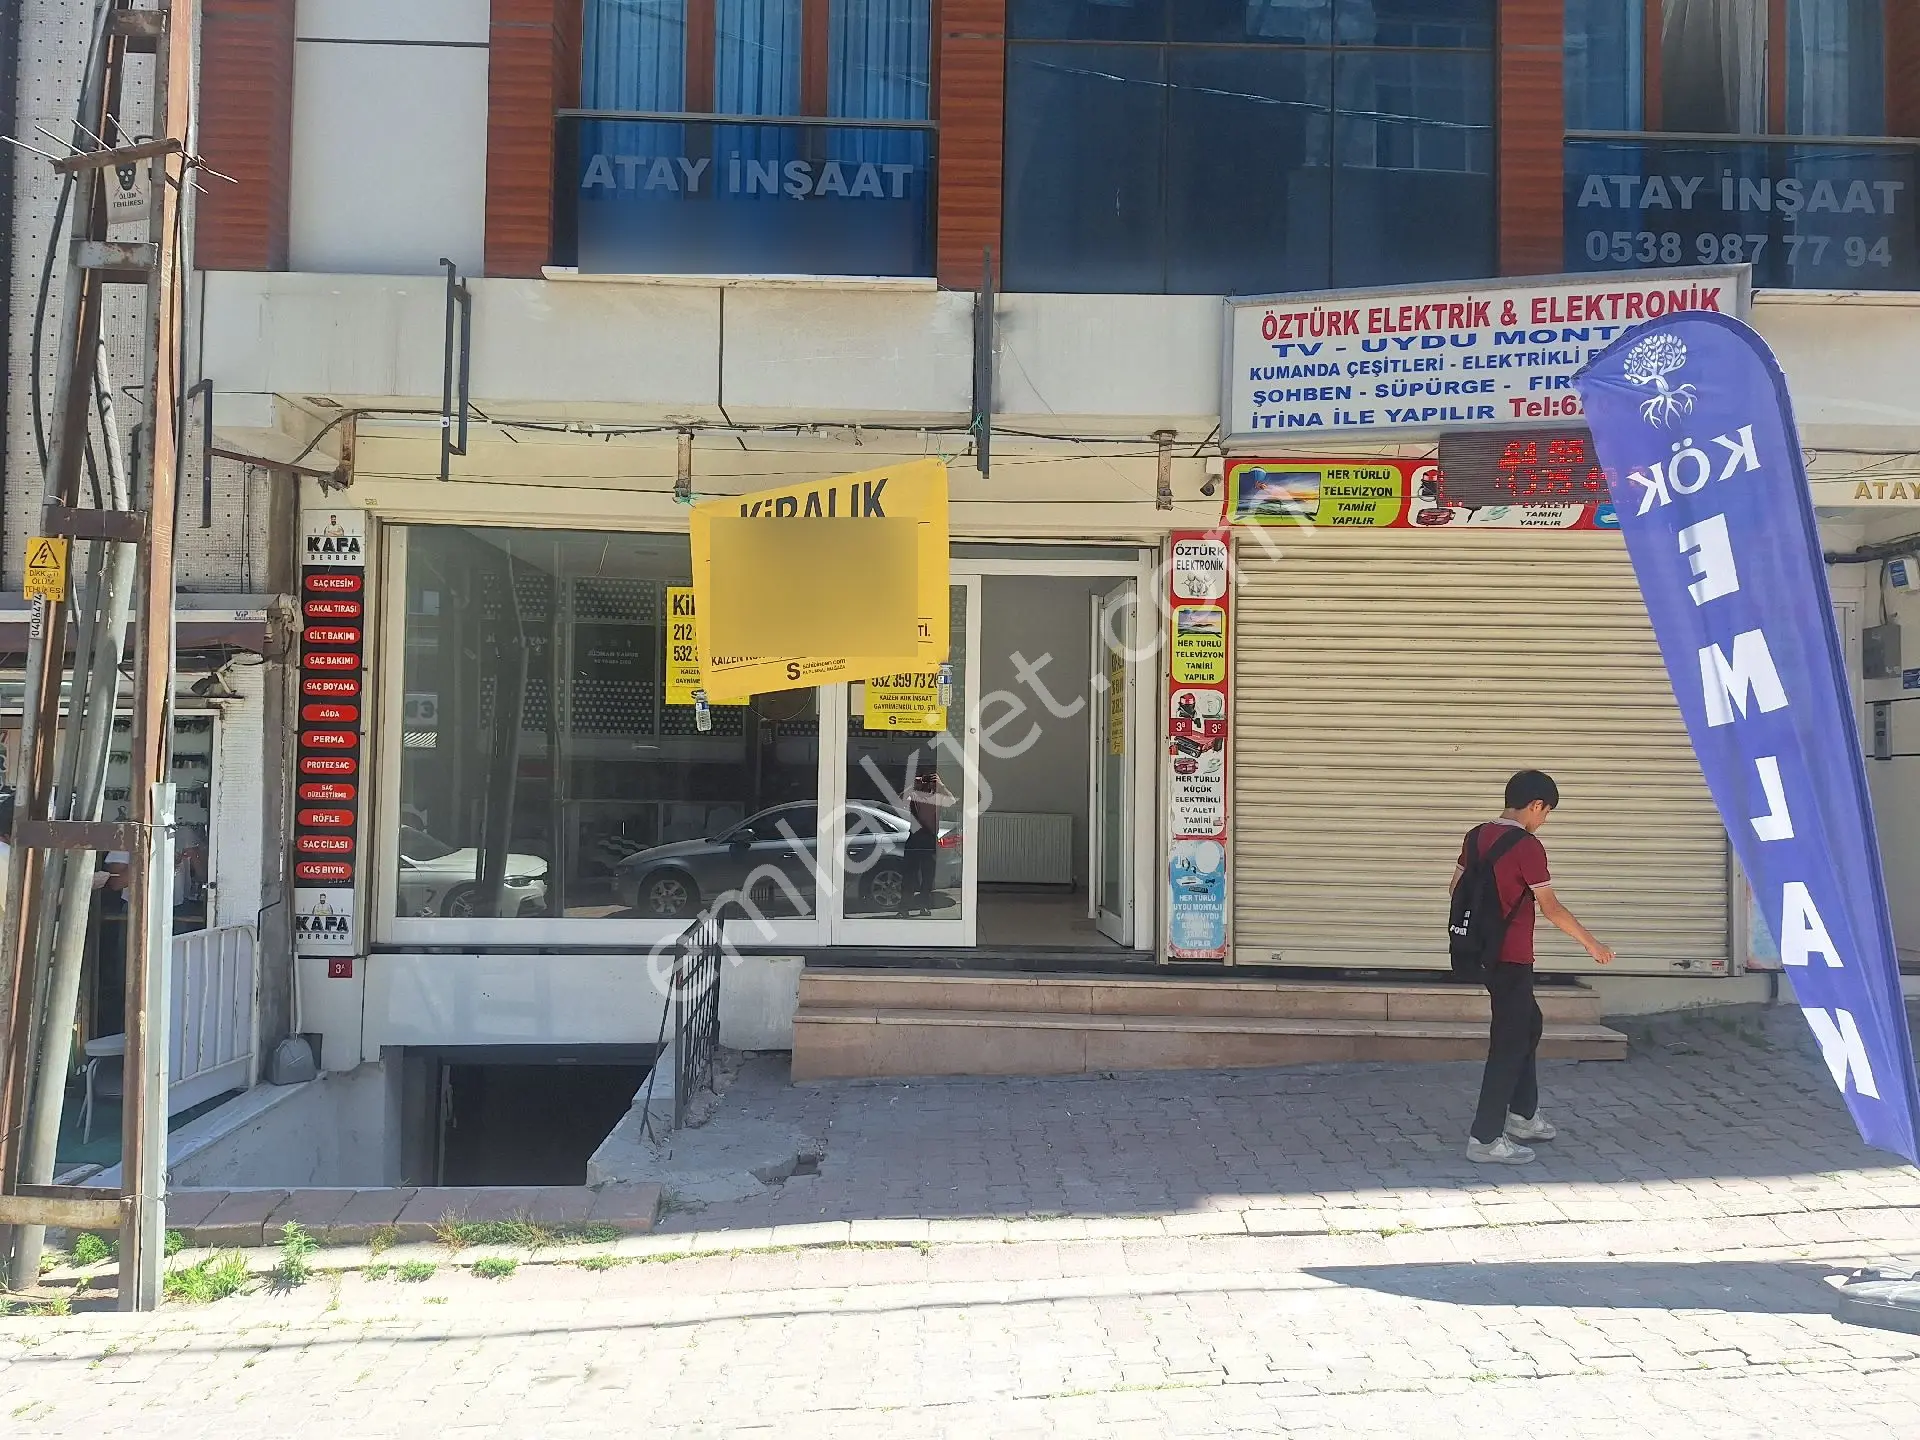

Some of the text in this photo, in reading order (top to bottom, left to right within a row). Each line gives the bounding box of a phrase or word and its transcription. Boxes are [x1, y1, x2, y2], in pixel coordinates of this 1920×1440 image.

[581, 151, 914, 200] ATAY İNŞAAT
[1577, 168, 1905, 221] ATAY İNŞAAT
[1585, 230, 1892, 268] 0538 987 77 94
[1261, 282, 1721, 341] ÖZTÜRK ELEKTRİK & ELEKTRONİK
[1271, 342, 1324, 358] TV
[1361, 333, 1477, 353] UYDU
[1250, 362, 1341, 381] KUMANDA
[1346, 354, 1444, 379] ÇEŞİTLERİ
[1462, 345, 1580, 370] ELEKTRİKLİ
[1252, 385, 1352, 407] ŞOHBEN
[1374, 378, 1495, 398] SÜPÜRGE
[1252, 410, 1324, 429] İTİNA
[1333, 407, 1375, 425] İLE
[1384, 405, 1495, 423] YAPILIR
[1327, 468, 1391, 480] HER TÜRLÜ
[1323, 484, 1393, 497] TELEVİZYON
[1337, 501, 1377, 511] TAMİRİ
[1332, 516, 1375, 525] YAPILIR
[307, 536, 361, 552] KAFA
[1175, 544, 1225, 556] ÖZTÜRK
[1176, 558, 1224, 571] ELEKTRONİK
[330, 578, 354, 588] KESİM
[309, 604, 357, 613] SAKAL TIRAŞI
[309, 630, 355, 641] CİLT BAKIMI
[673, 624, 692, 641] 212
[673, 645, 692, 662] 532
[1175, 649, 1224, 659] TELEVİZYON
[326, 656, 353, 665] BAKIMI
[892, 672, 912, 688] 359
[913, 672, 926, 689] 73
[1184, 673, 1215, 681] YAPILIR
[323, 683, 355, 691] BOYAMA
[313, 735, 345, 744] PERMA
[307, 761, 335, 769] PROTEZ
[1175, 795, 1221, 803] ELEKTRİKLİ
[312, 813, 340, 823] RÖFLE
[321, 866, 345, 874] BIYIK
[295, 916, 350, 933] KAFA
